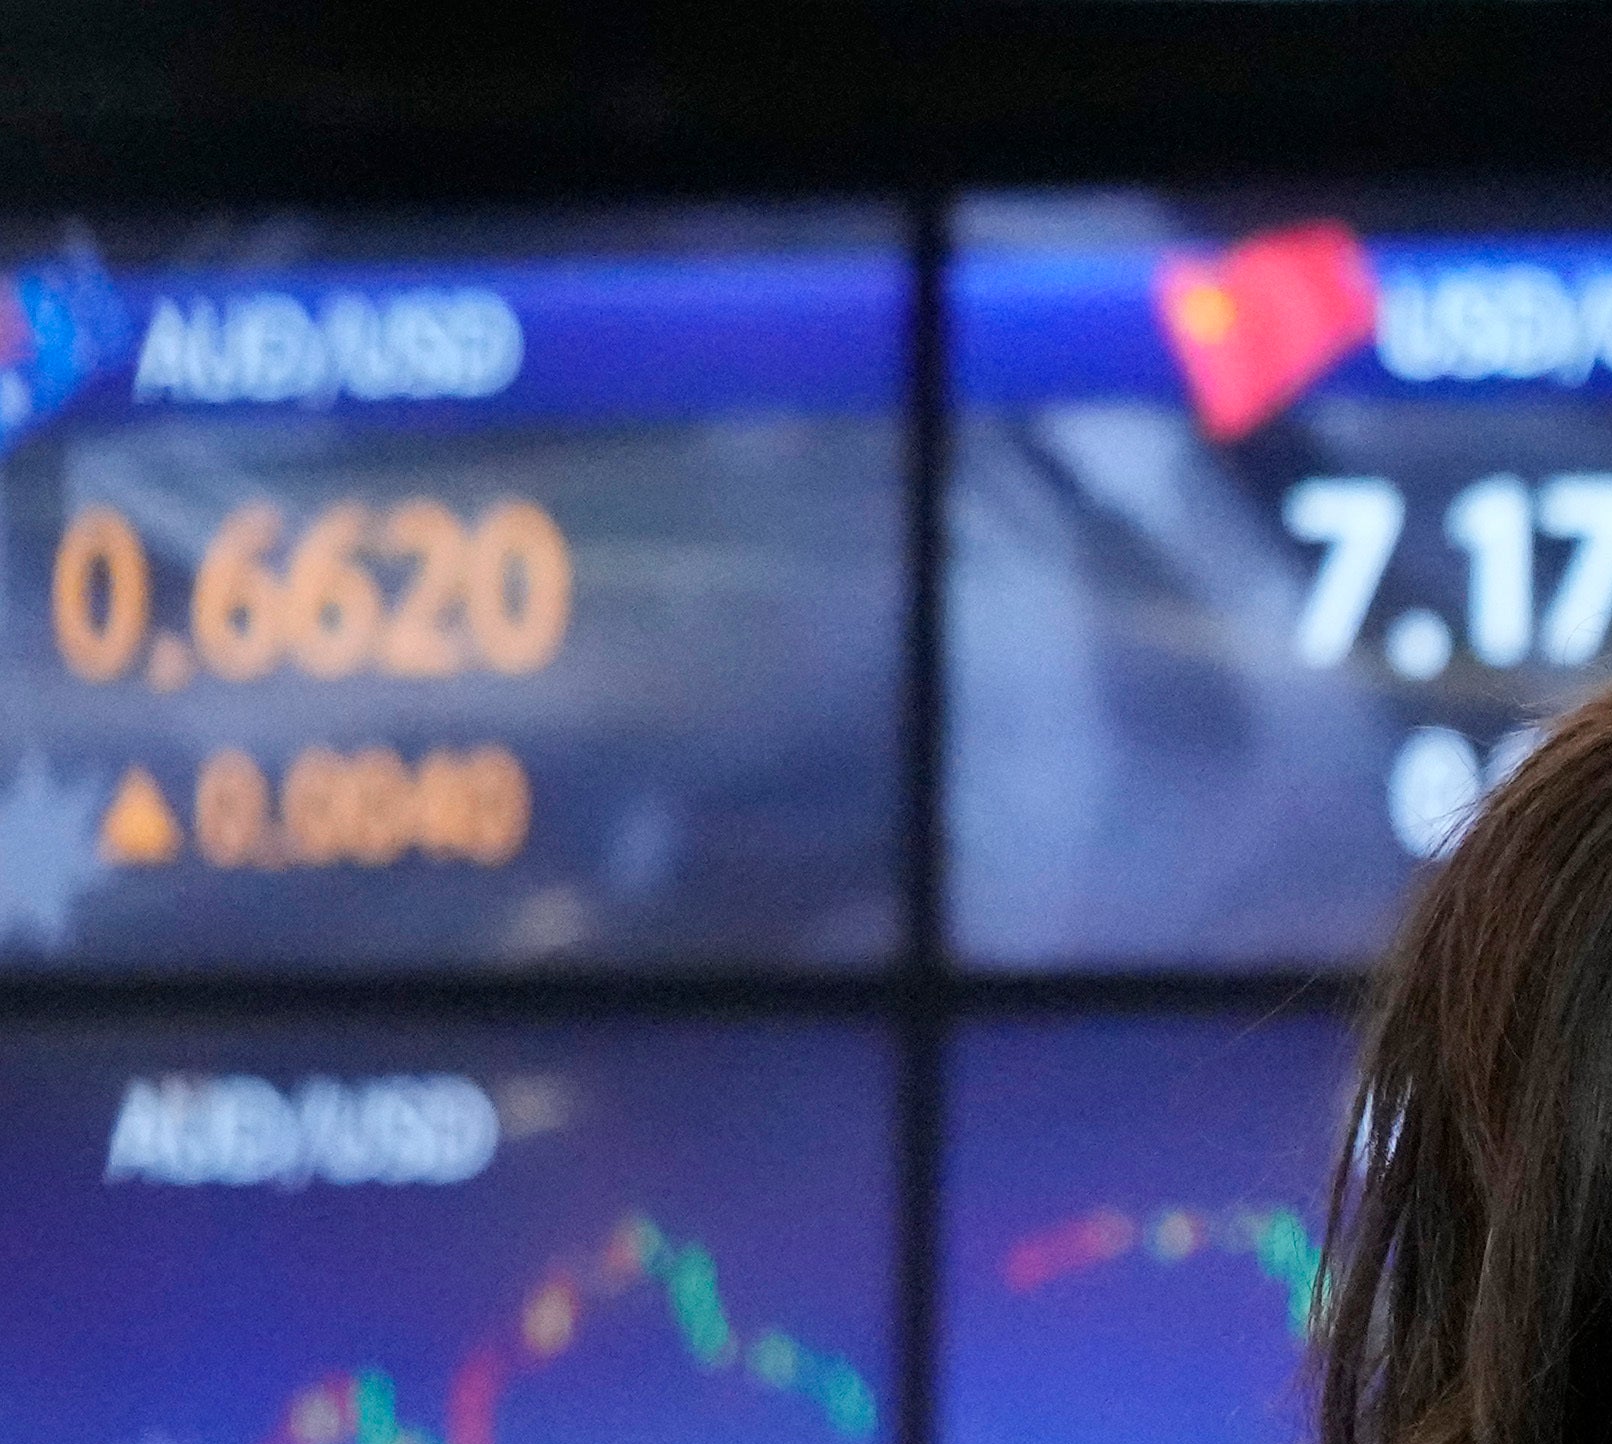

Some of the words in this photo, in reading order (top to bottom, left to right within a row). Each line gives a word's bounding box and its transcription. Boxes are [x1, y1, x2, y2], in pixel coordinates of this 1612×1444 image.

[135, 287, 522, 400] AUD/USD
[52, 498, 572, 690] 0.6620
[104, 1072, 501, 1187] AUD/USD
